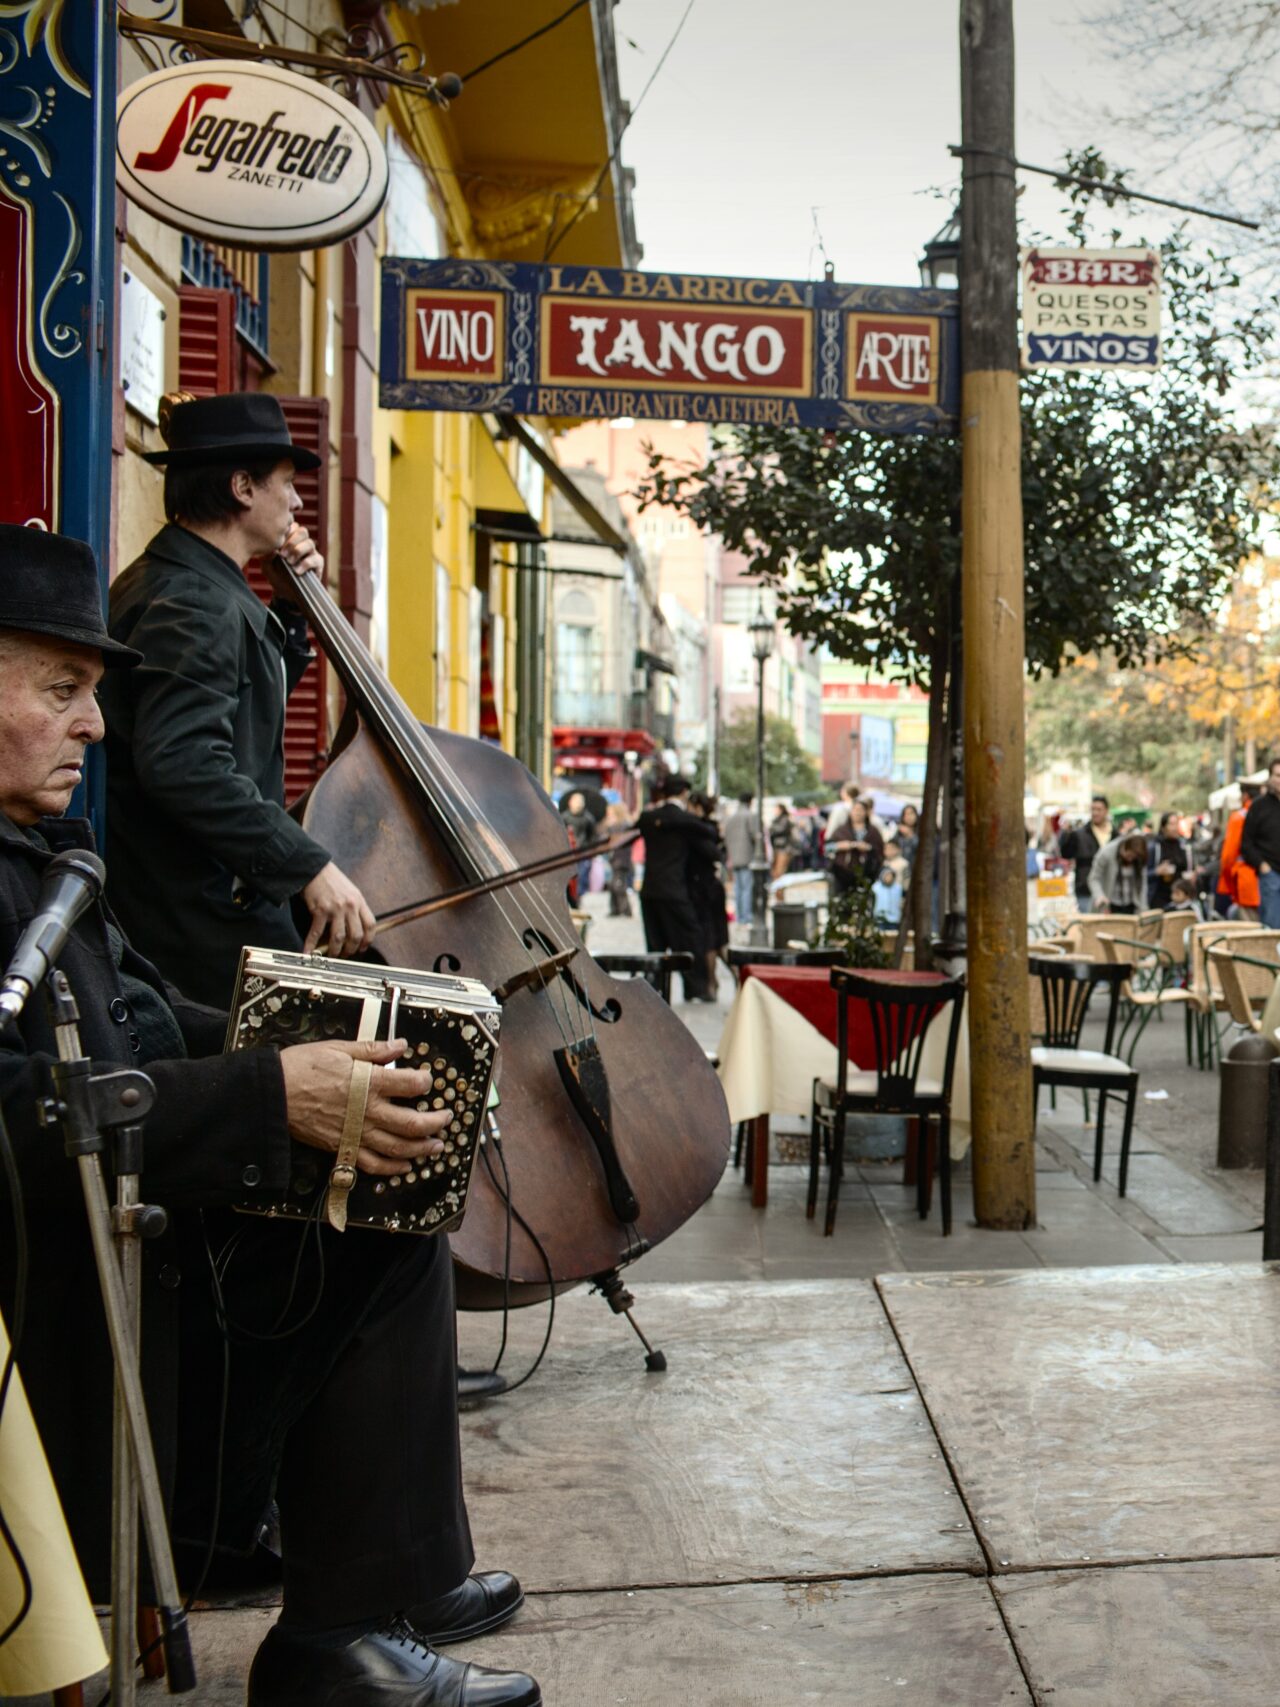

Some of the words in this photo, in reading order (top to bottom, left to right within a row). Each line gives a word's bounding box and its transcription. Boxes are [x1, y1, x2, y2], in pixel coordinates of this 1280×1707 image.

[134, 83, 352, 184] Segafredo
[228, 166, 303, 193] ZANETTI
[550, 267, 611, 295] LA
[620, 272, 803, 305] BARRICA
[1045, 260, 1138, 283] BAR
[1037, 293, 1147, 310] QUESOS
[416, 308, 494, 362] VINO
[1038, 313, 1147, 328] PASTAS
[569, 315, 786, 381] TANGO
[856, 331, 930, 389] ARTE
[1037, 339, 1149, 360] VINOS
